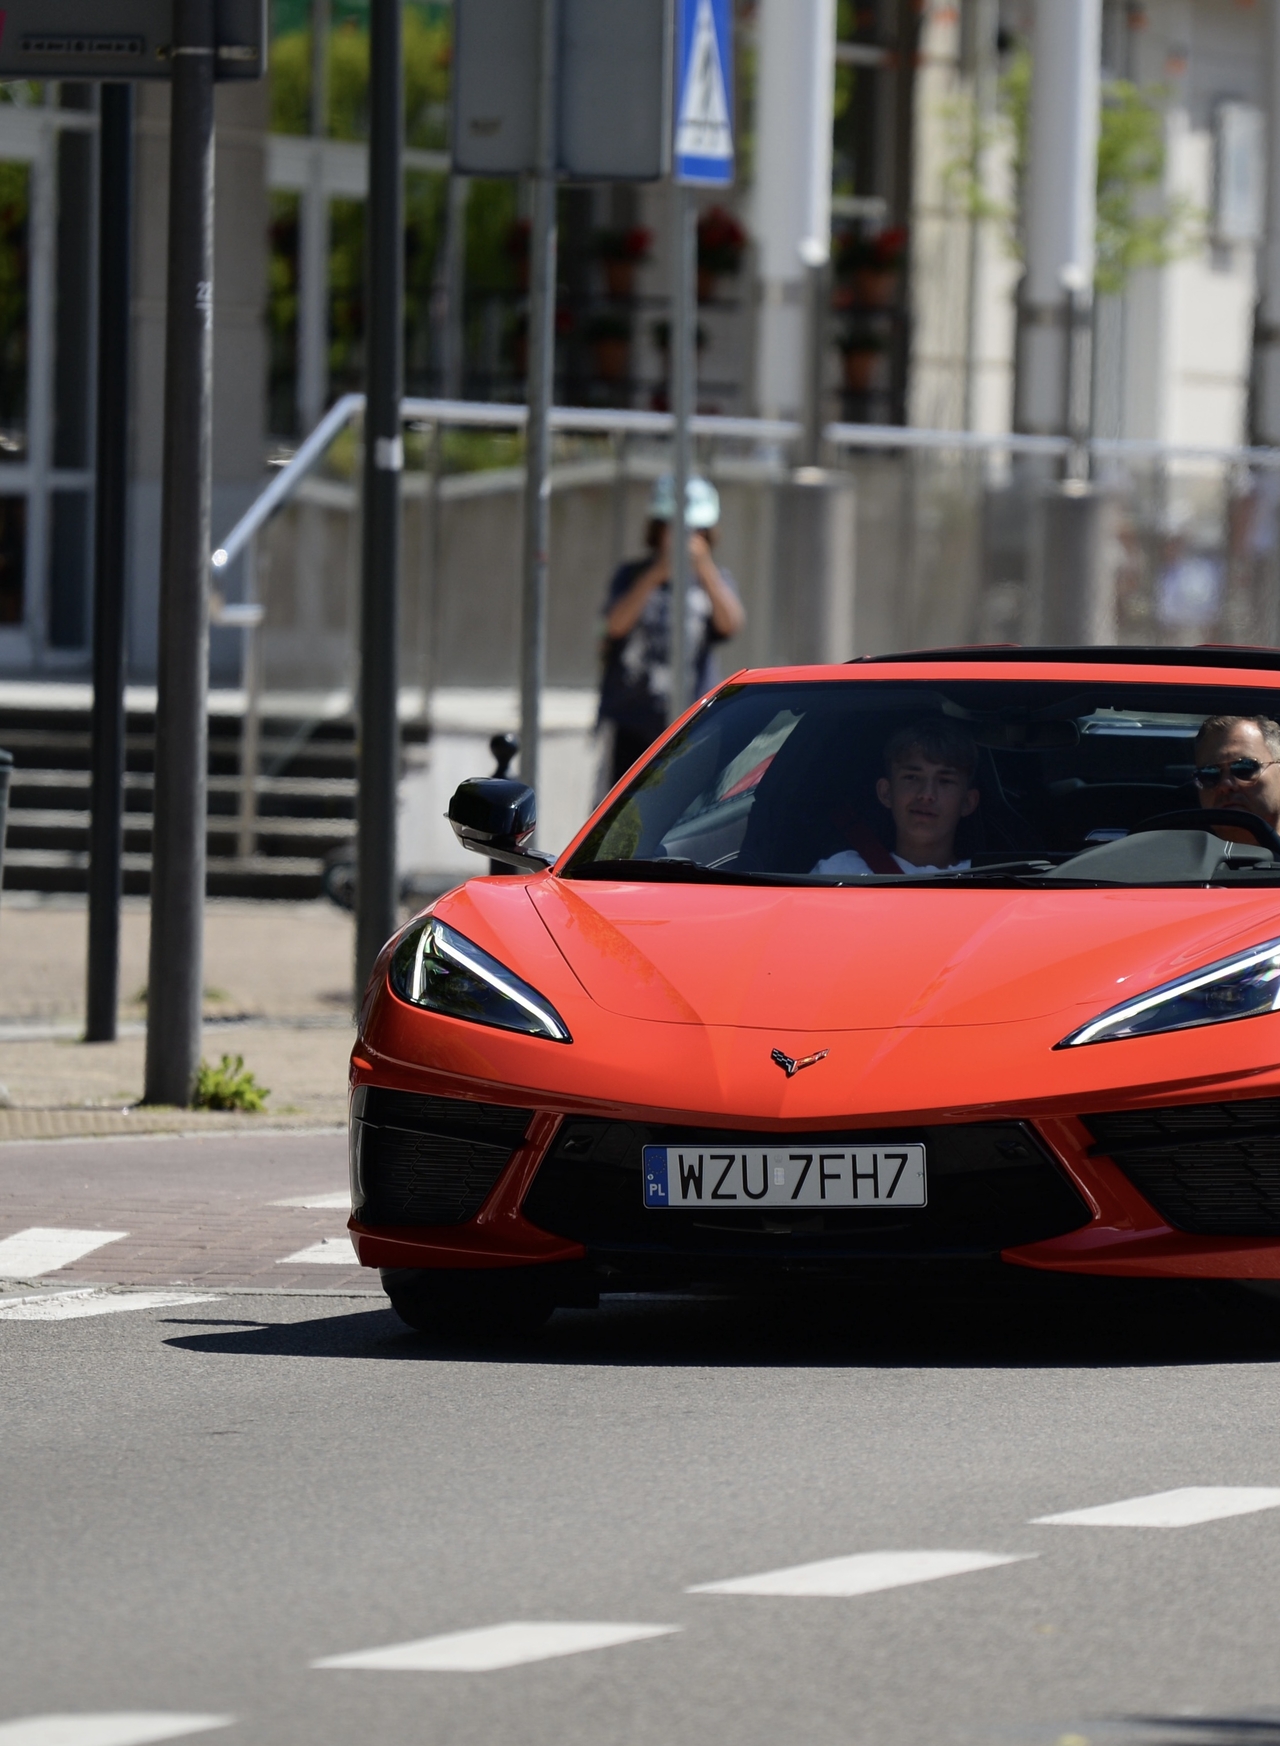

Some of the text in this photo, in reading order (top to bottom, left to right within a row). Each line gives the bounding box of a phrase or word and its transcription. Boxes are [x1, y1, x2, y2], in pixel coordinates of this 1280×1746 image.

[650, 1184, 665, 1196] PL
[678, 1153, 908, 1200] WZU 7FH7
